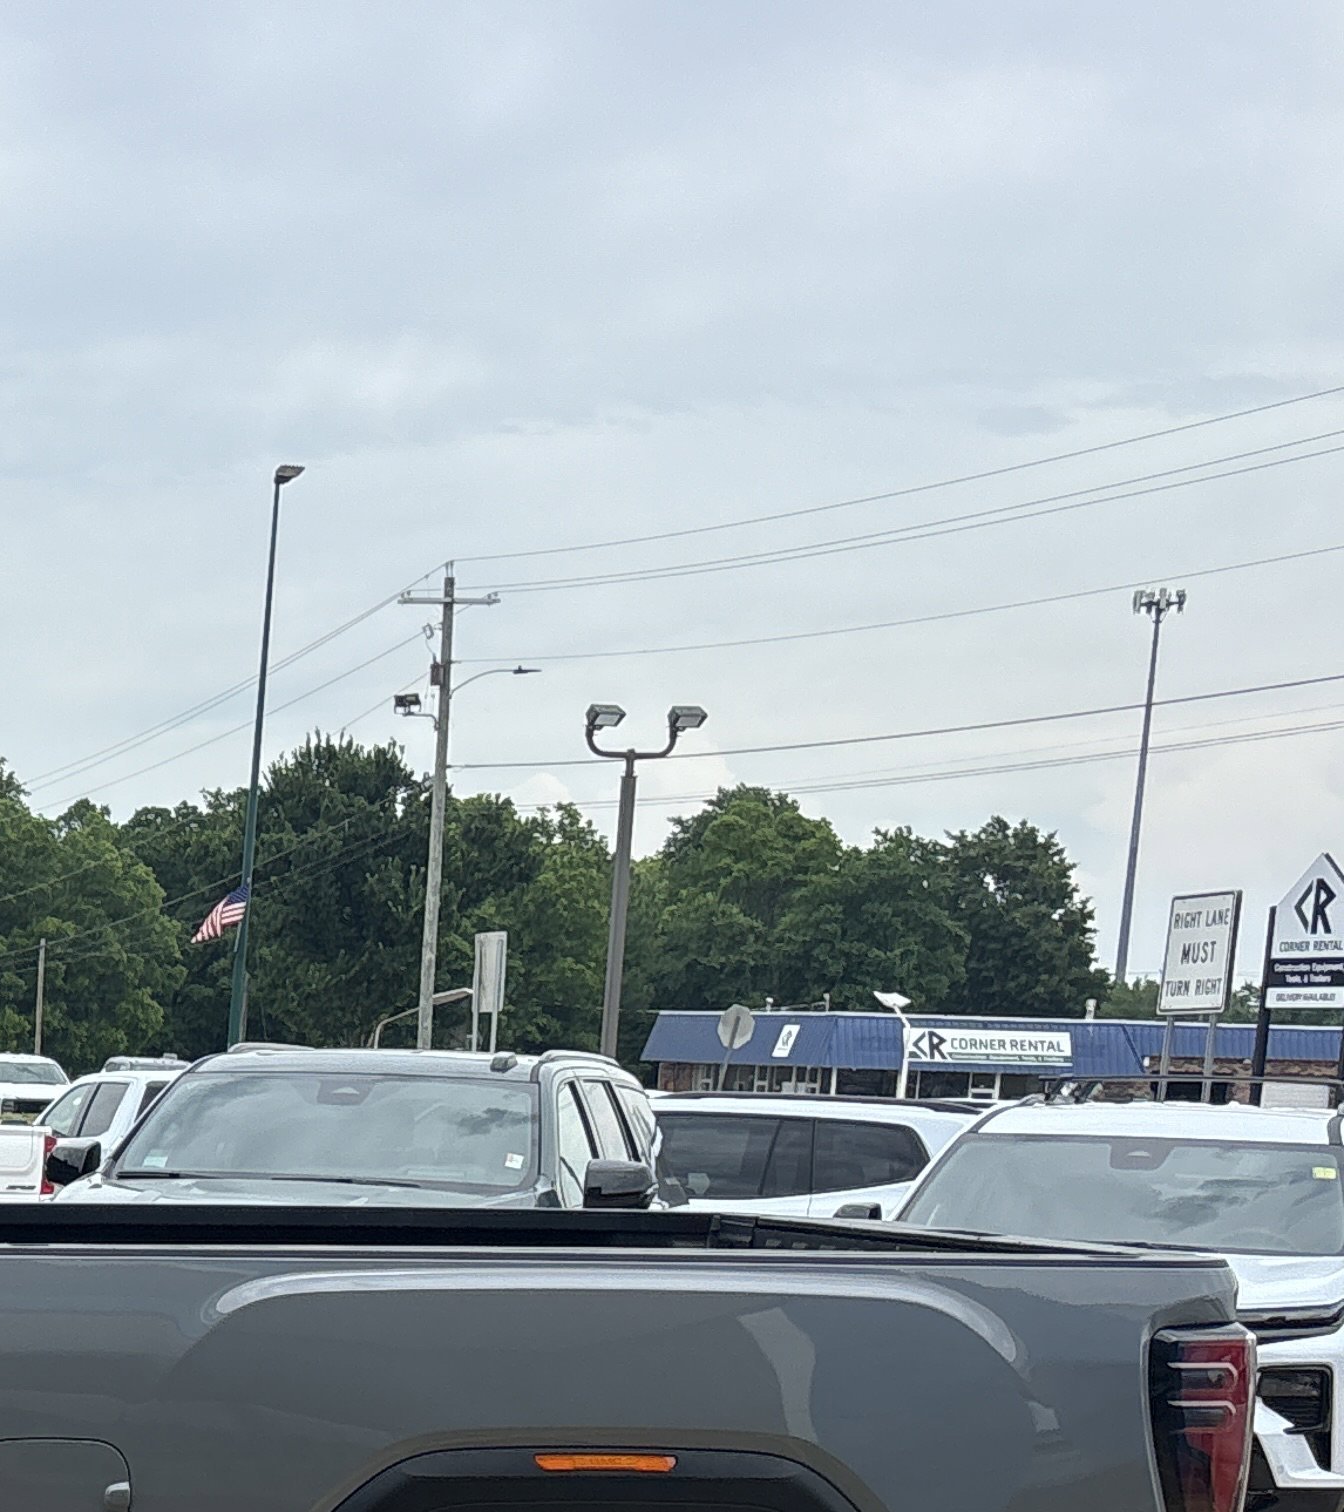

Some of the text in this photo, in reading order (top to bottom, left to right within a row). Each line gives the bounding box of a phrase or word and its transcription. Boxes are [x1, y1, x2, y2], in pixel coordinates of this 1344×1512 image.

[1173, 908, 1230, 929] RIGHT LANE
[1180, 941, 1217, 965] MUST
[1313, 940, 1343, 951] RENTAL
[1165, 978, 1222, 997] TURN RIGHT
[950, 1037, 1065, 1053] CORNER RENTAL
